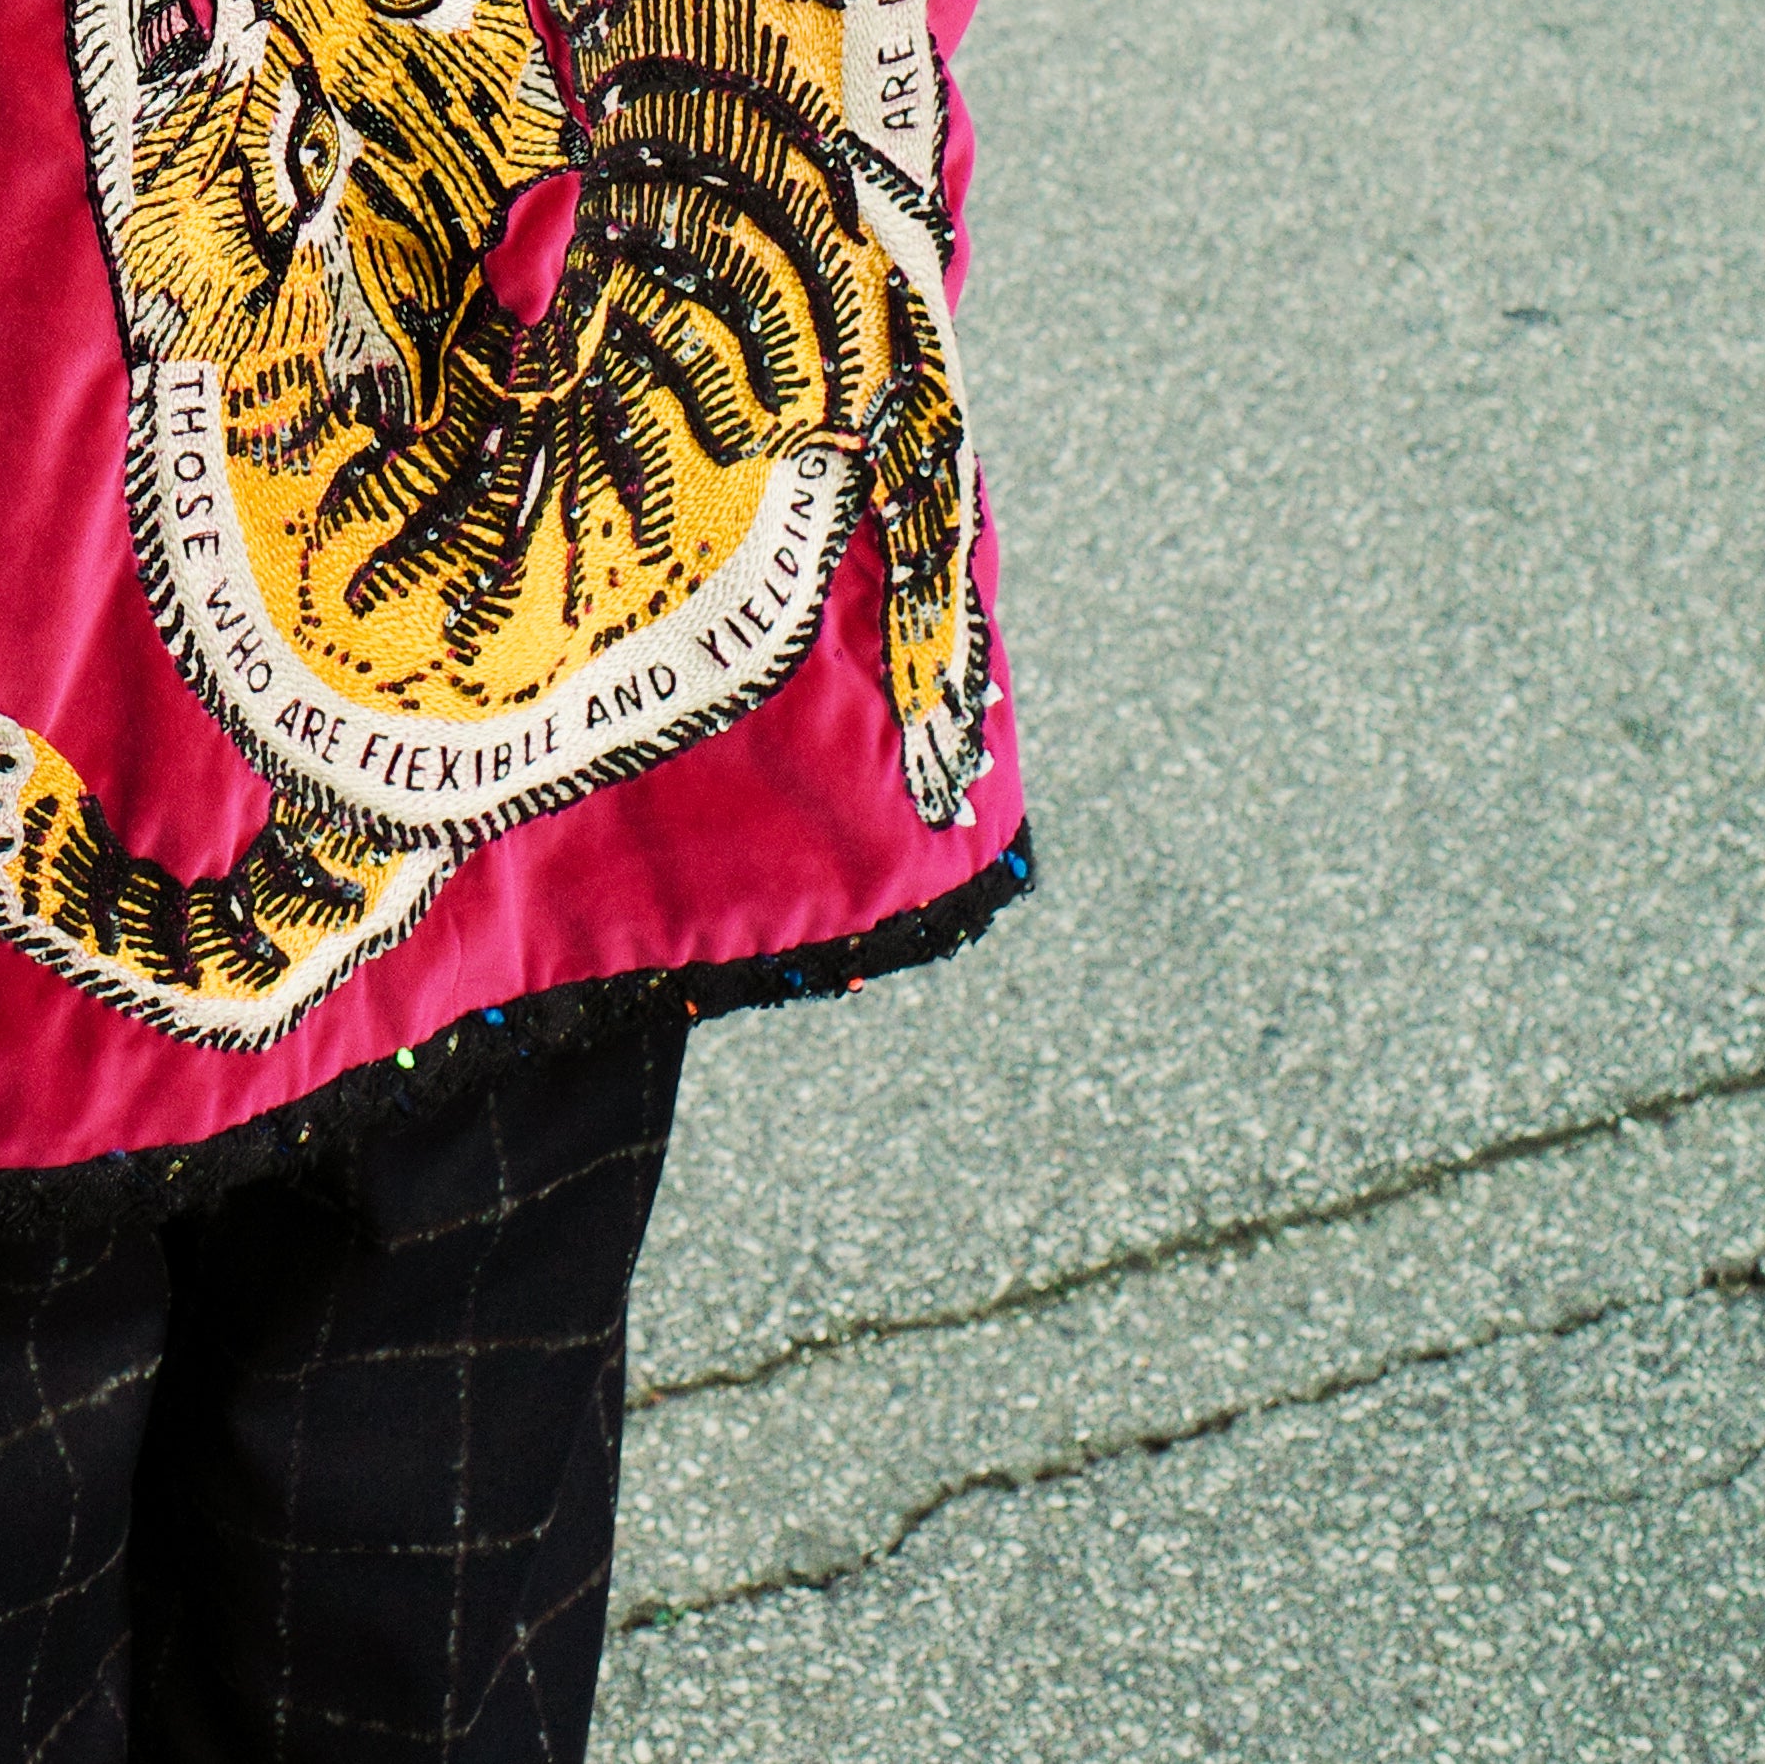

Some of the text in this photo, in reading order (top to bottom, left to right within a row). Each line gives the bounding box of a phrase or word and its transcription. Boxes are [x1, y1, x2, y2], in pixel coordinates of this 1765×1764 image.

[878, 33, 918, 132] ARE
[169, 369, 828, 793] THOSE WHO ARE FLEXIBLE AND YIELDING
